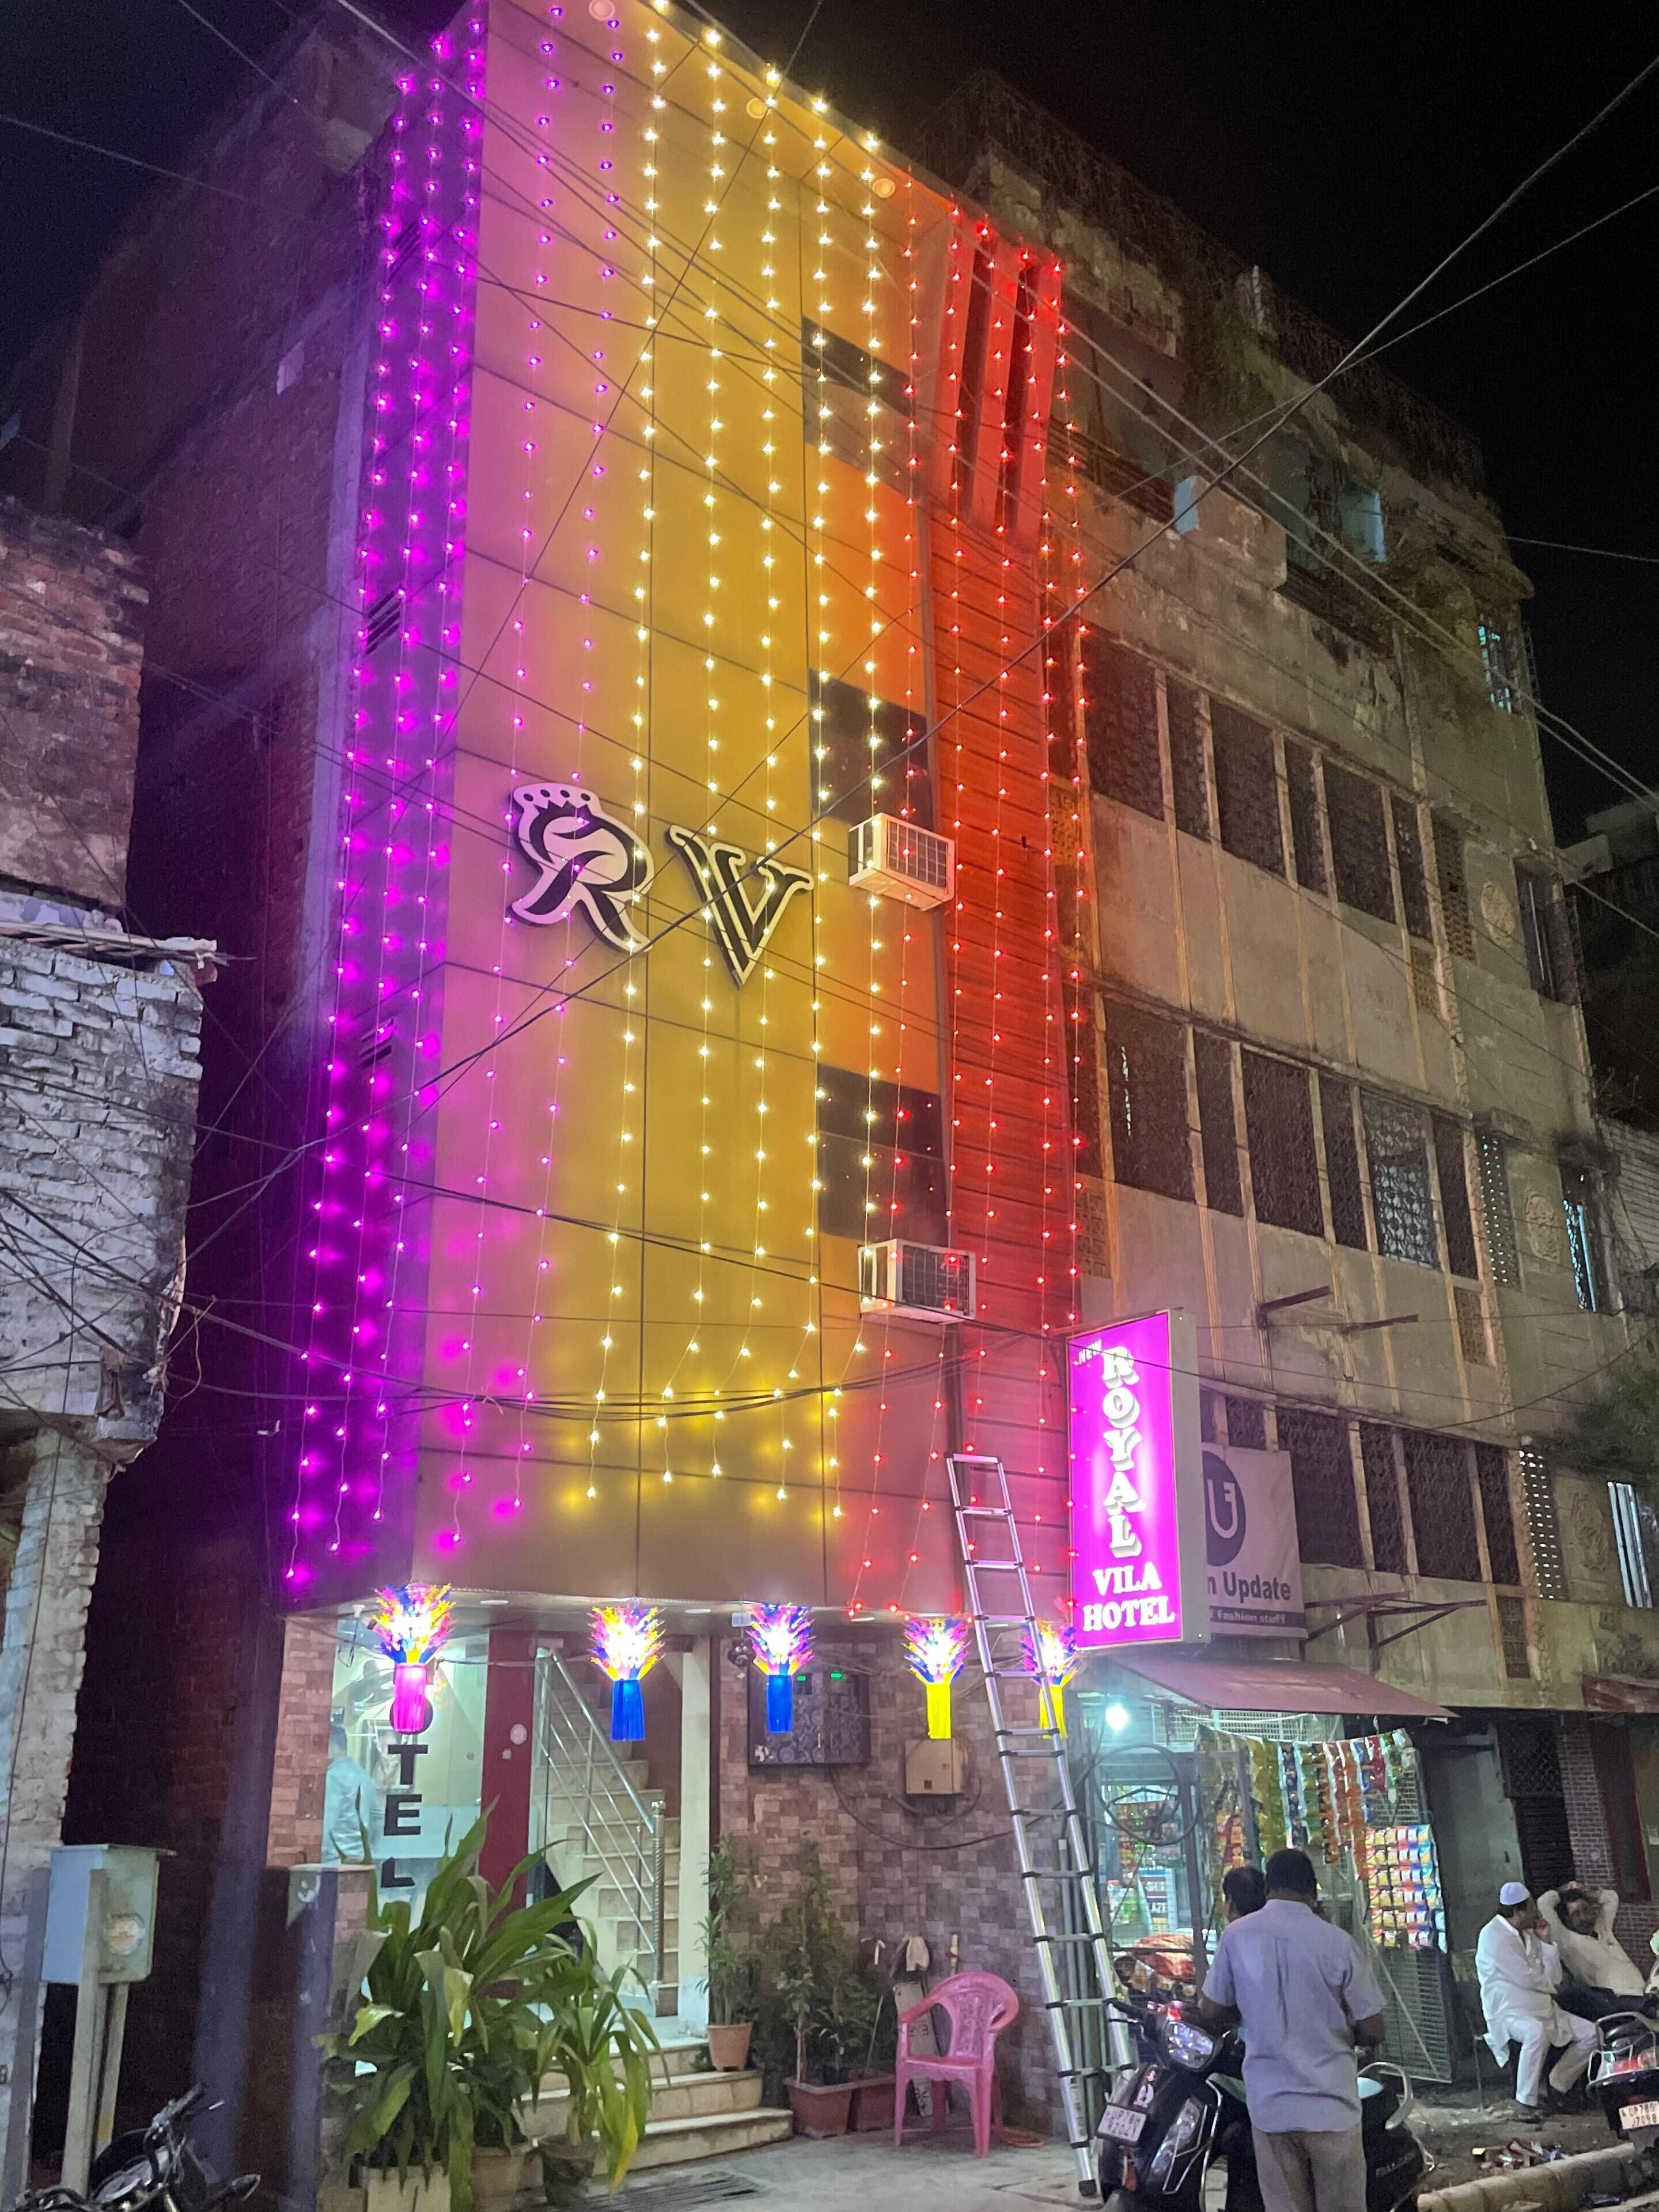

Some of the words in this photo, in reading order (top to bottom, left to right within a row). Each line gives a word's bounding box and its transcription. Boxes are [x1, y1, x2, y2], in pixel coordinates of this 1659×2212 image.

[1078, 1339, 1101, 1364] NEW
[1101, 1346, 1144, 1559] ROYAL
[1093, 1563, 1161, 1595] VILA
[1222, 1571, 1290, 1604] Update
[1083, 1597, 1175, 1631] HOTEL
[1217, 1609, 1257, 1622] fashion
[1259, 1613, 1286, 1624] stuff
